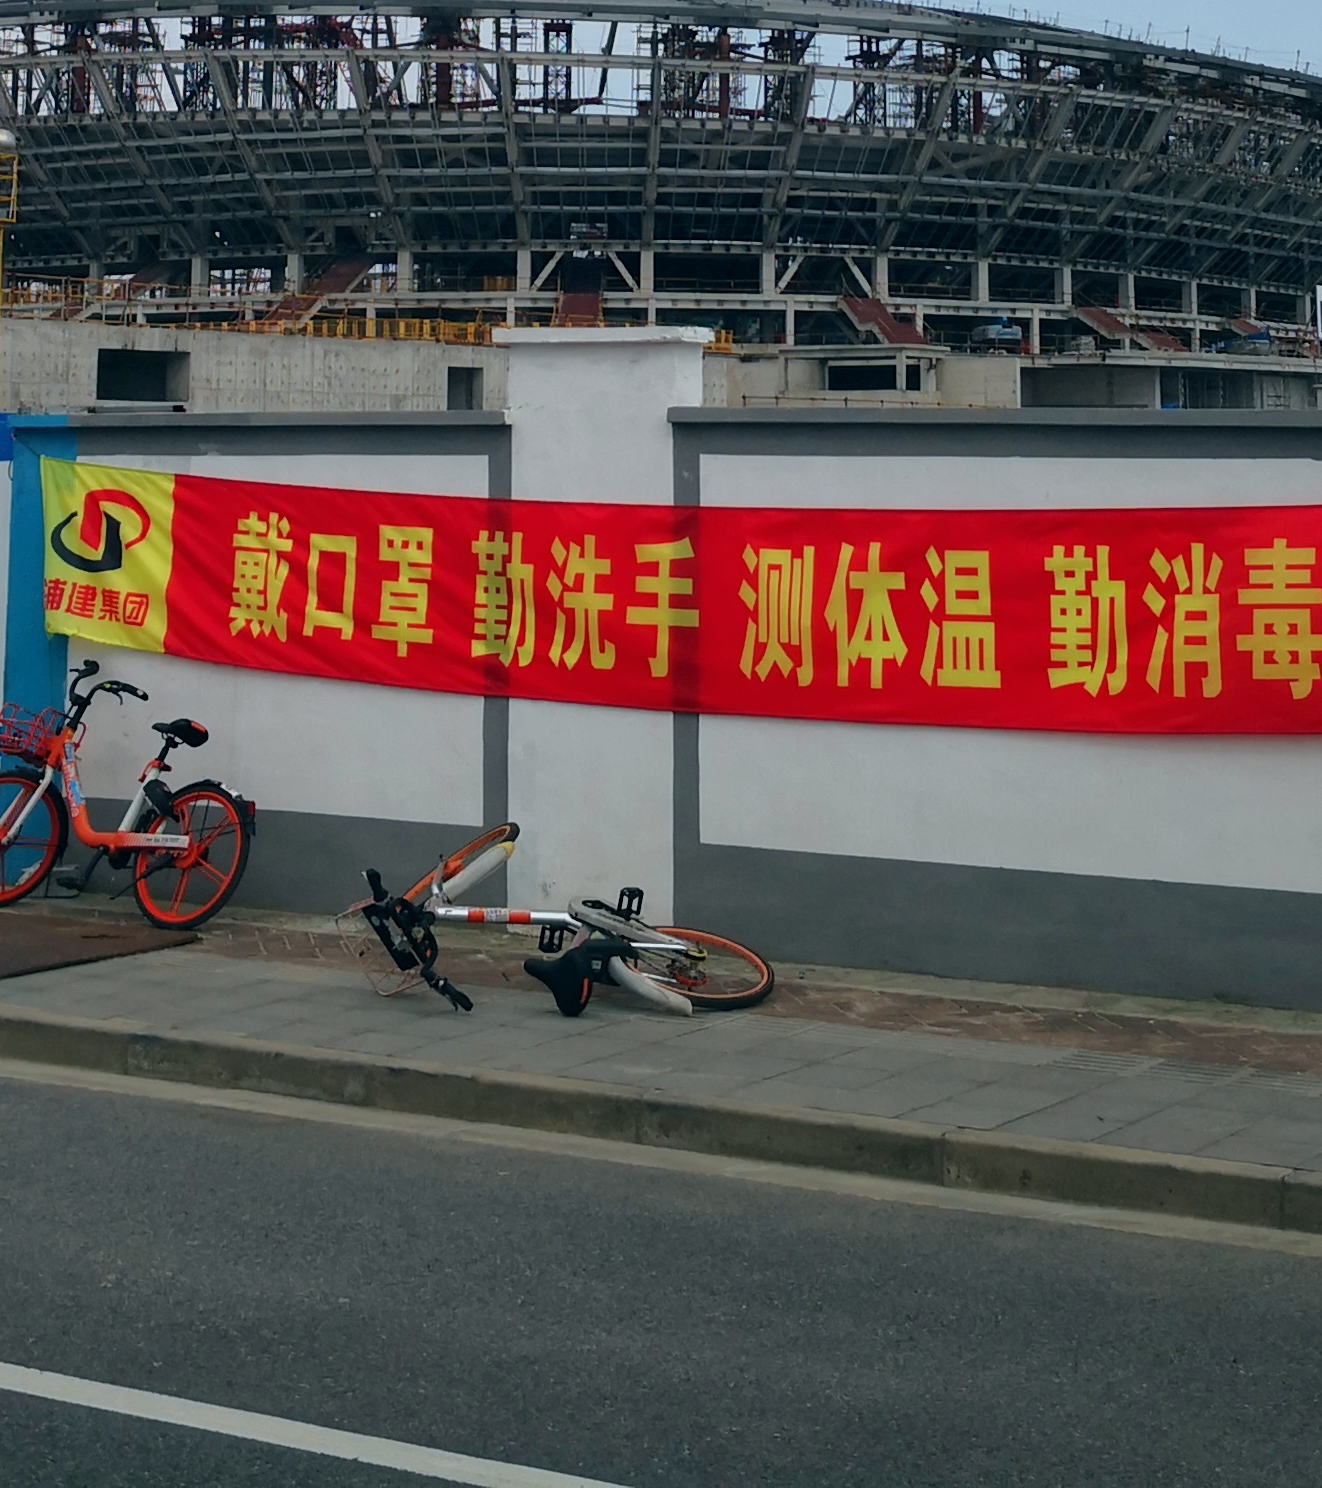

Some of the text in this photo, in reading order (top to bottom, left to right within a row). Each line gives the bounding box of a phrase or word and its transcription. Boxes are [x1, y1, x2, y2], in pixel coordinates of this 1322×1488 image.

[229, 511, 434, 657] 戴口罩
[471, 530, 700, 678] 勤洗手
[739, 542, 1002, 689] 测体温
